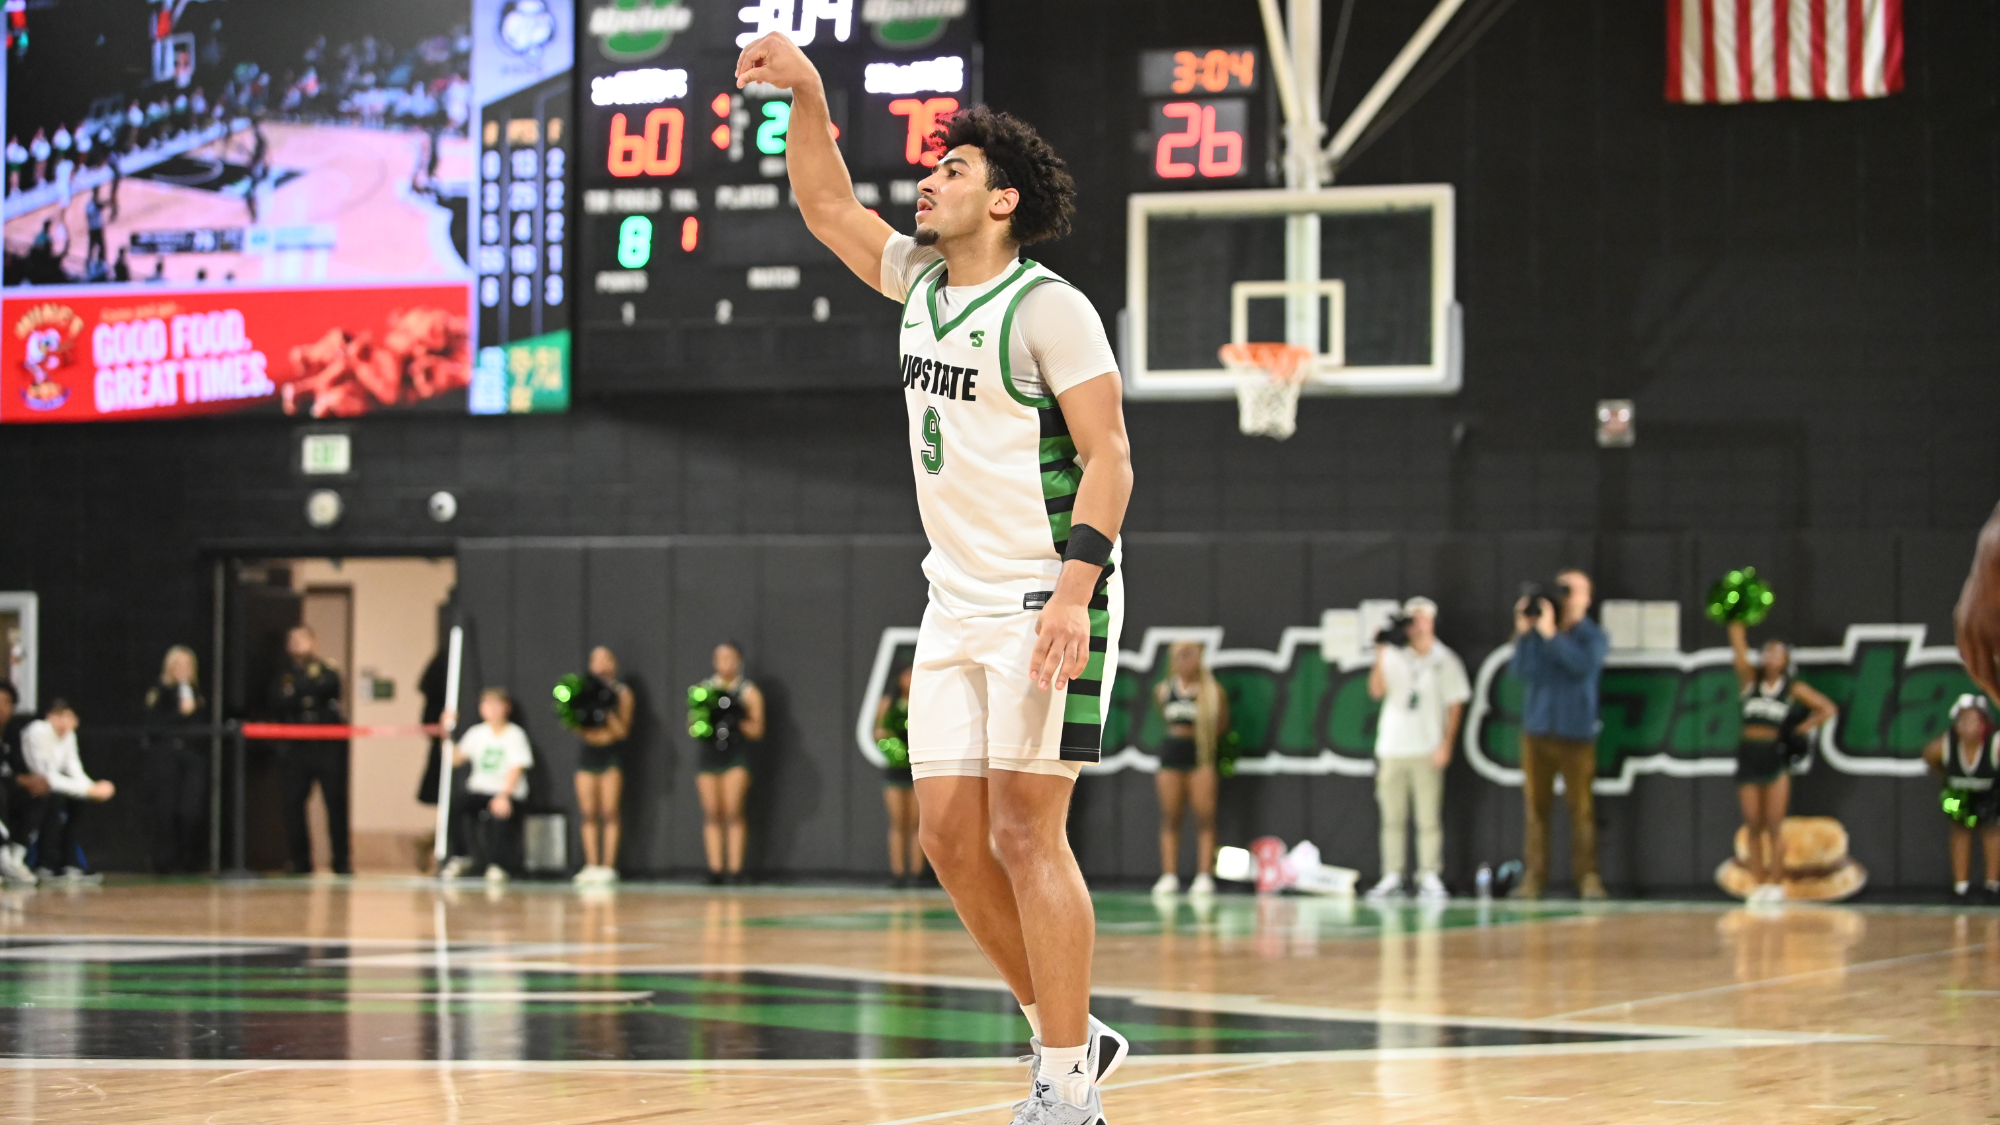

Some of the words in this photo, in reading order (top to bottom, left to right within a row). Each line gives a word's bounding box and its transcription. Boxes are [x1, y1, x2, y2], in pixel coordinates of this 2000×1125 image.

[1171, 49, 1254, 94] 3:04
[608, 108, 684, 177] 60
[757, 101, 791, 154] 2
[1156, 102, 1243, 178] 26
[618, 215, 652, 269] 8
[92, 317, 168, 369] GOOD
[170, 309, 252, 360] FOOD.
[94, 360, 178, 413] GREAT
[181, 350, 275, 404] TIMES.
[902, 354, 979, 402] UPSTATE
[921, 405, 944, 475] 9
